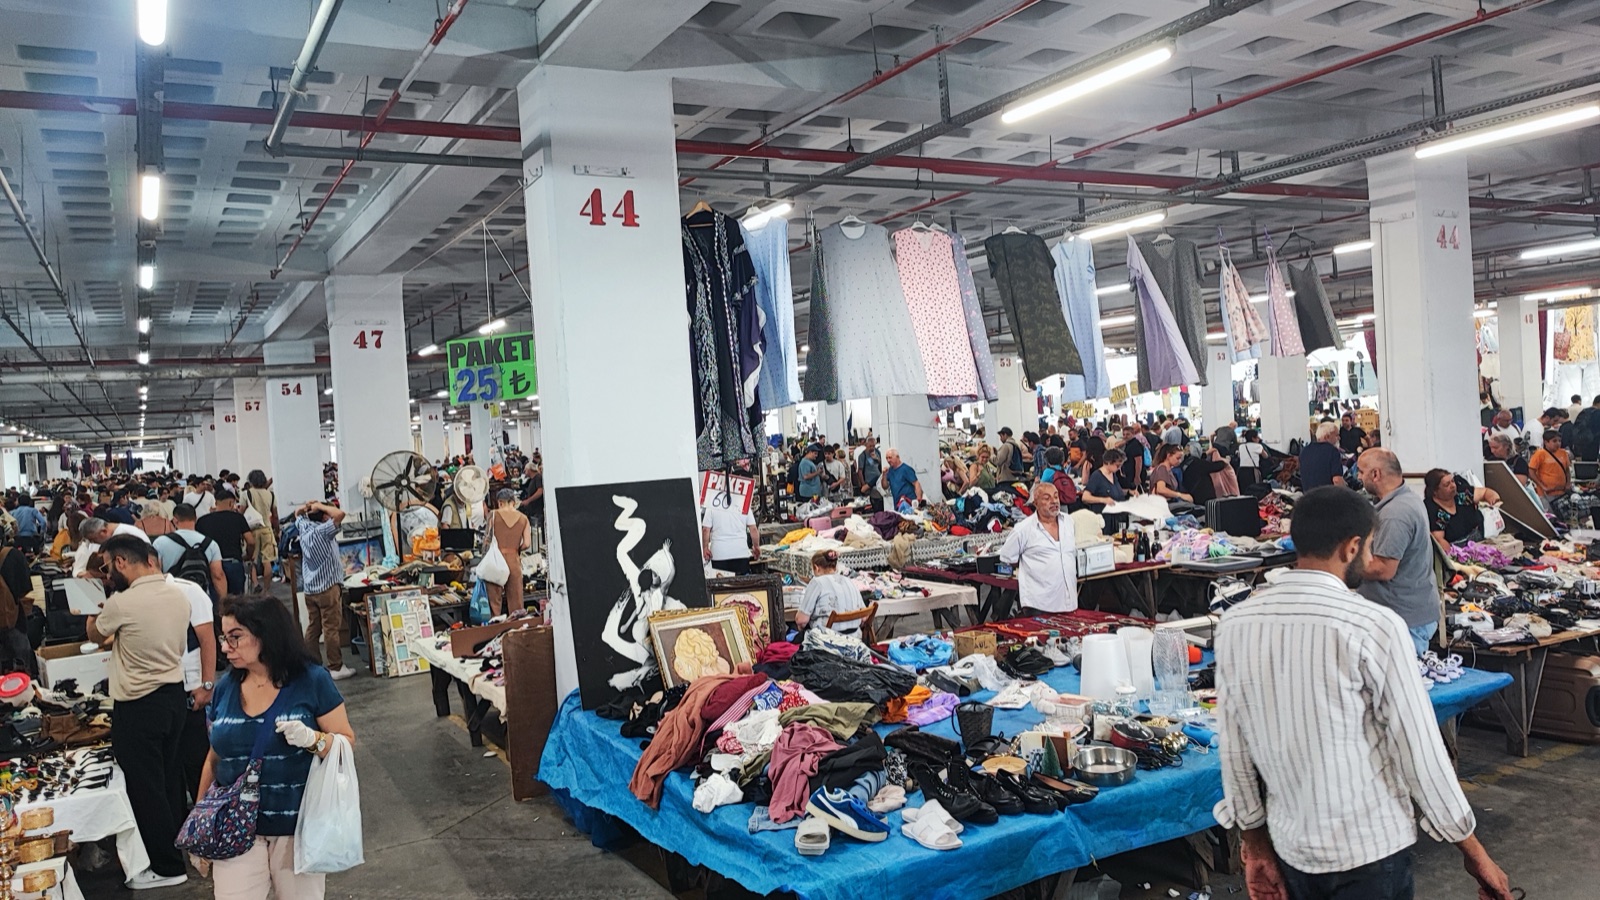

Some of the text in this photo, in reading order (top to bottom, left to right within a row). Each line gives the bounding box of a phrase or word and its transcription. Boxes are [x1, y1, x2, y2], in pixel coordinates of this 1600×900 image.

[579, 188, 640, 227] 44
[1436, 224, 1460, 250] 44
[353, 330, 384, 349] 47
[449, 335, 533, 368] PAKET
[1000, 357, 1011, 368] 53
[281, 383, 302, 396] 54
[456, 367, 498, 402] 25
[245, 401, 260, 411] 57
[224, 415, 236, 423] 62
